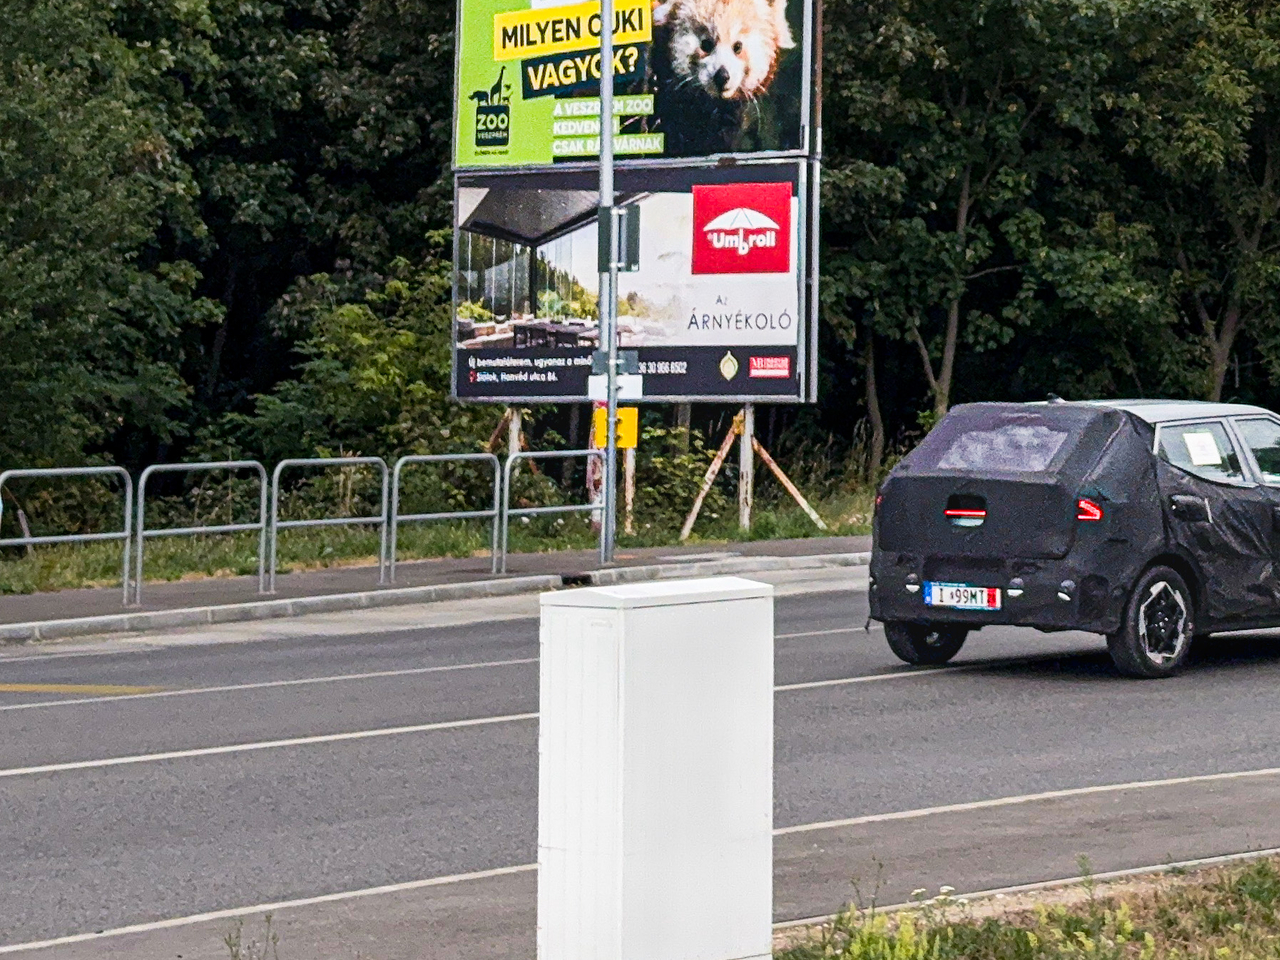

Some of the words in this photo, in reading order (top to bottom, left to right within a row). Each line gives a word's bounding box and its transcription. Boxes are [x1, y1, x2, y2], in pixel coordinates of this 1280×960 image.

[502, 16, 581, 49] MILYEN
[626, 98, 652, 114] ZOO
[477, 113, 508, 130] ZOO
[553, 139, 584, 154] CSAK
[613, 135, 662, 152] VÁRNAK
[687, 307, 792, 330] ÁRNYÉKOLÓ
